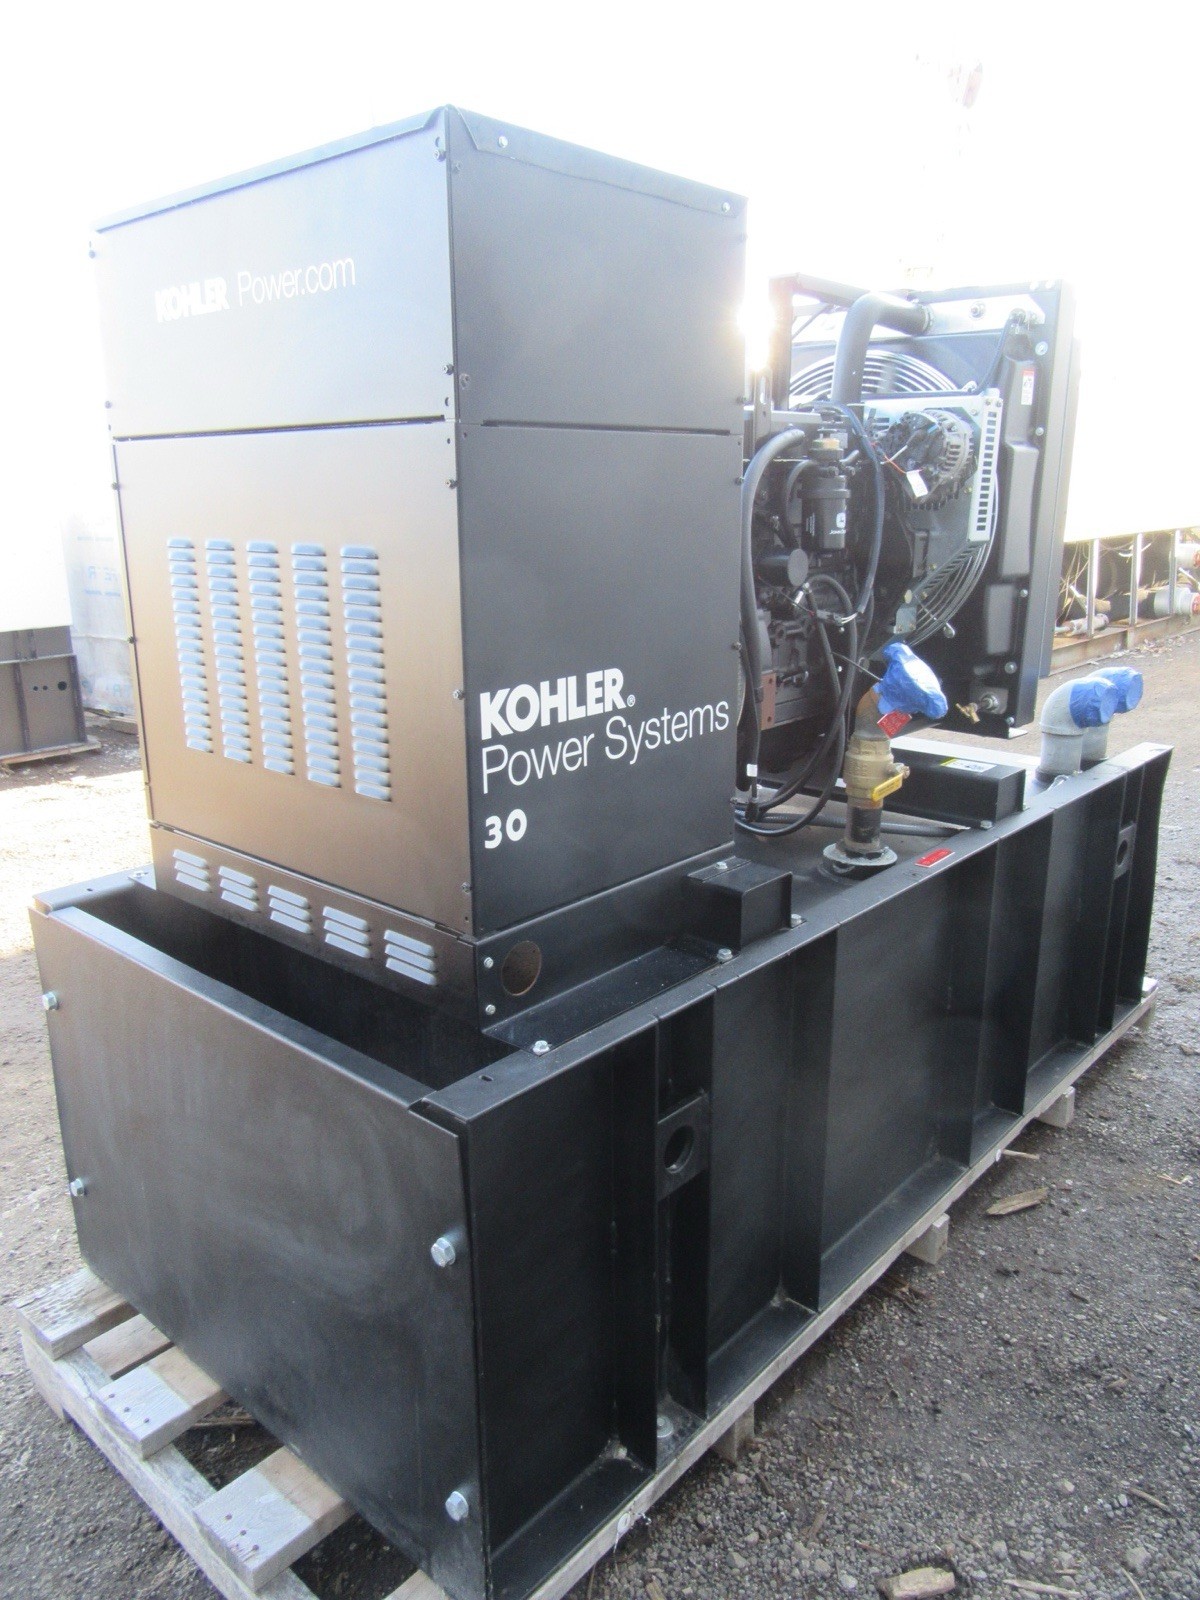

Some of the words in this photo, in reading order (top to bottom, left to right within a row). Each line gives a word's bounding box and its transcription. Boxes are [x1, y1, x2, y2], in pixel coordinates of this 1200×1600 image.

[155, 276, 230, 323] KOHLER
[237, 257, 356, 307] Power.com
[482, 733, 595, 794] Power
[605, 701, 730, 765] Systems
[484, 808, 528, 849] 30
